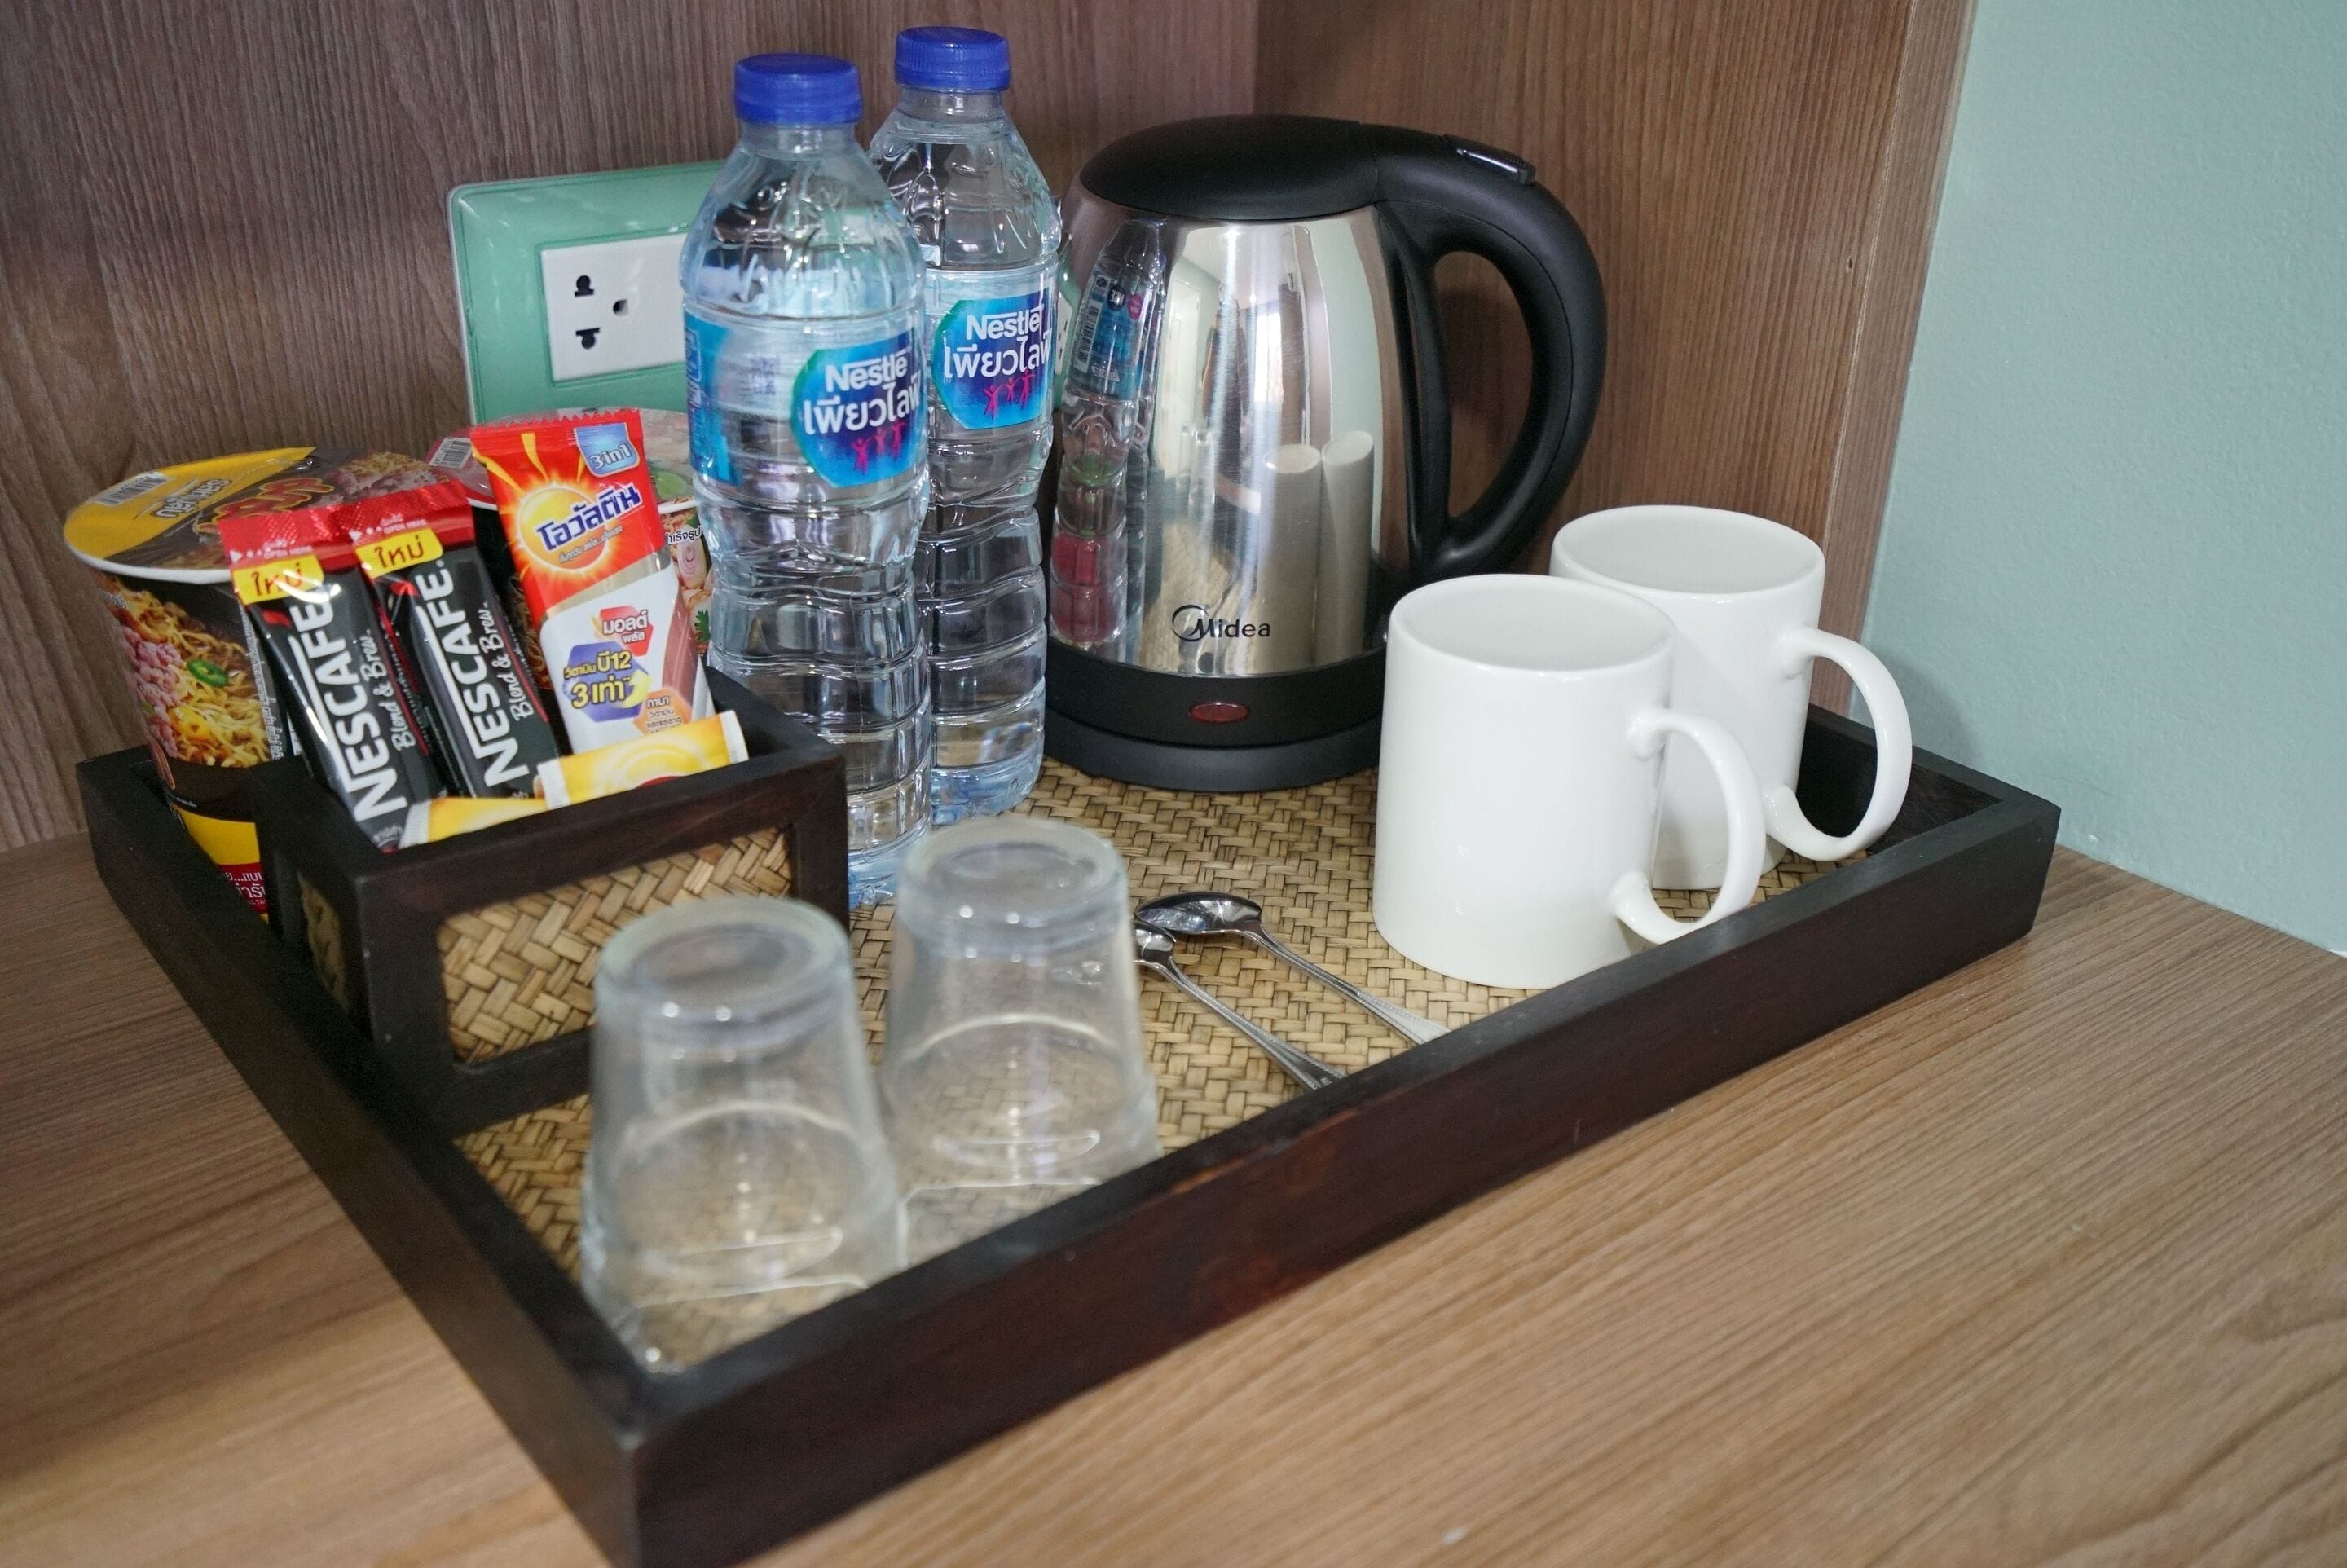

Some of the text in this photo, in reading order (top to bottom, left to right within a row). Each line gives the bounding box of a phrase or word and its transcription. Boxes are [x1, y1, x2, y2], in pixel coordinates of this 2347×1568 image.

[375, 535, 425, 569] ใหม่
[1171, 604, 1271, 642] Midea
[491, 654, 512, 669] &
[372, 682, 394, 698] &
[497, 670, 535, 722] Blend
[378, 699, 416, 752] Blend
